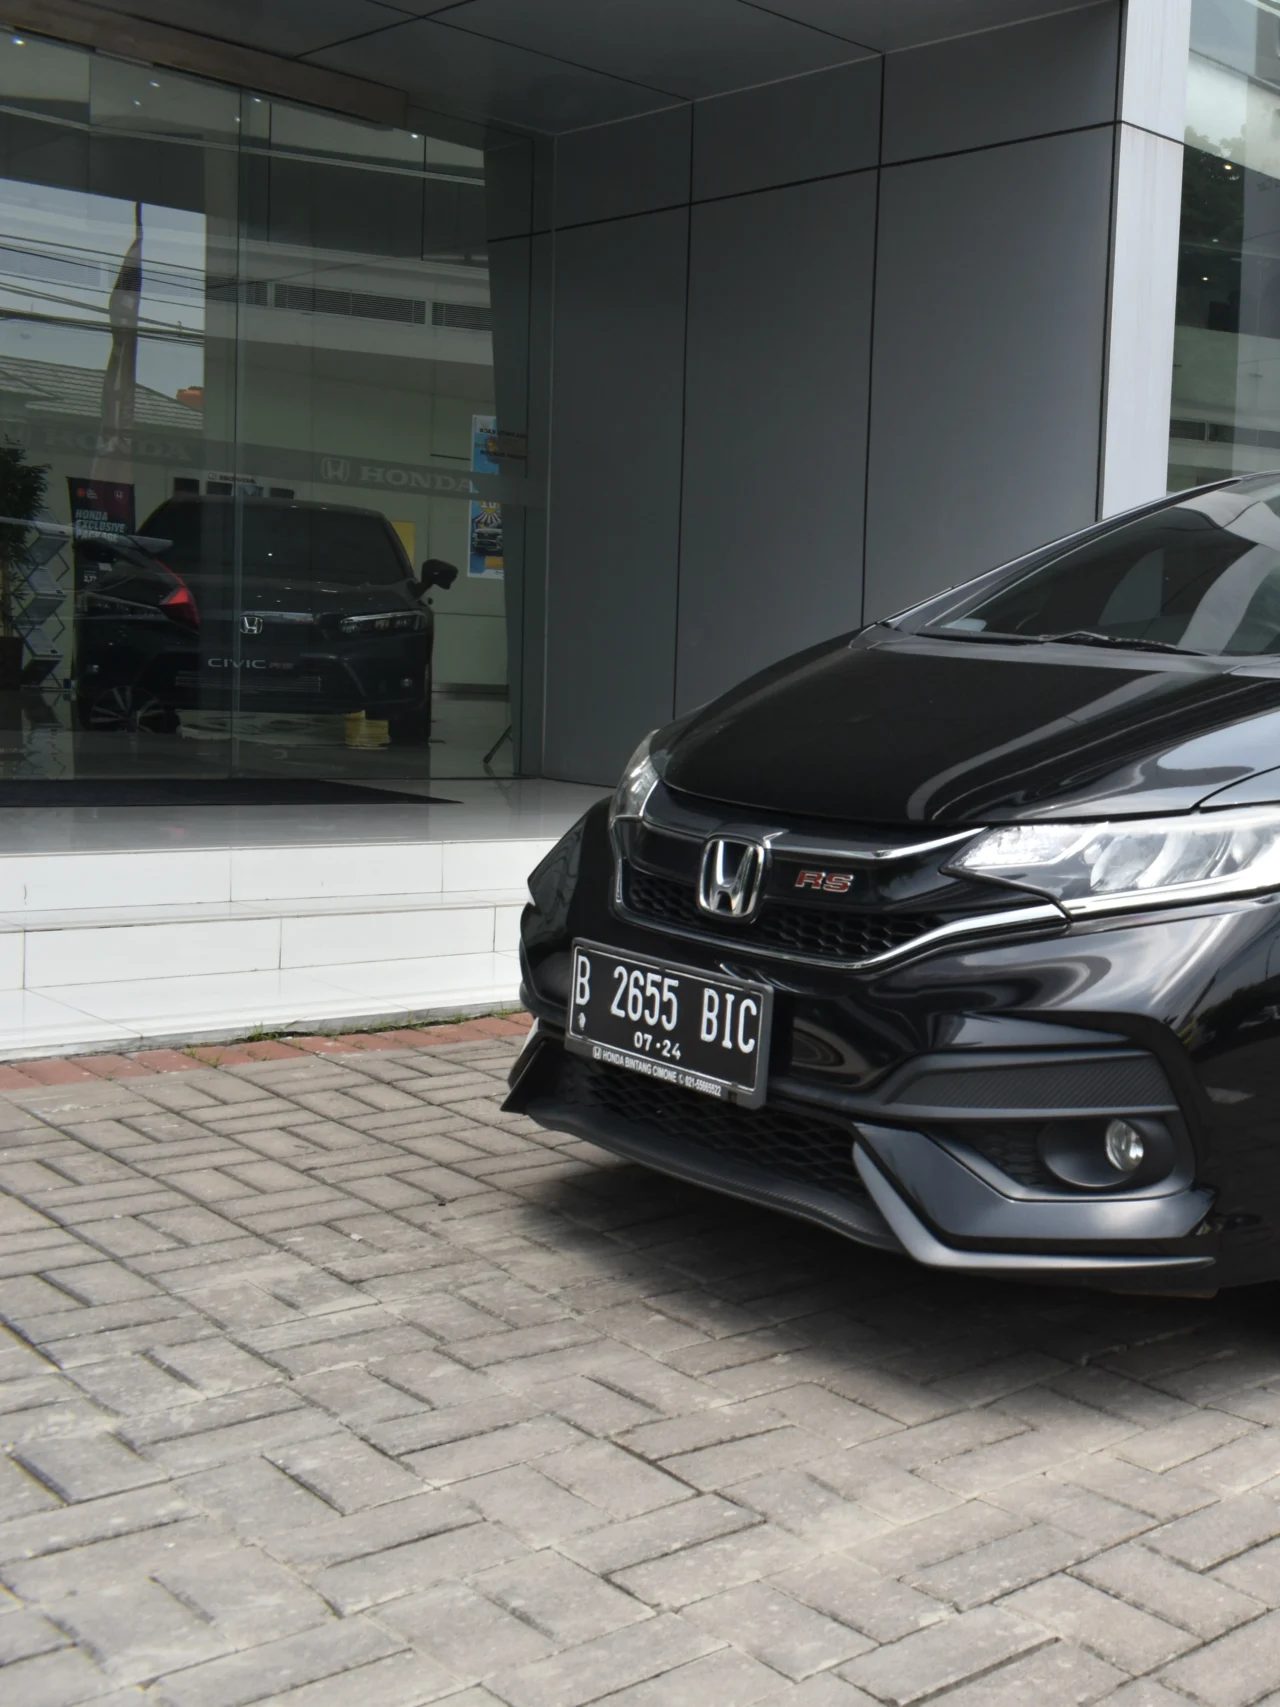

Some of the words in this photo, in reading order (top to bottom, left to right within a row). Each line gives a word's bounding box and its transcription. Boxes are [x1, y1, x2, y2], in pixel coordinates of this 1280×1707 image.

[360, 465, 481, 494] HONDA
[75, 509, 108, 521] HONDA
[76, 520, 126, 533] EXCLUSIVE
[208, 658, 267, 669] CIVIC
[795, 870, 854, 893] RS
[575, 955, 590, 1005] B
[610, 965, 679, 1031] 2655
[700, 987, 757, 1054] BIC
[602, 1050, 624, 1067] HONDA
[624, 1056, 652, 1074] BINTANG
[652, 1065, 677, 1083] CIMONE
